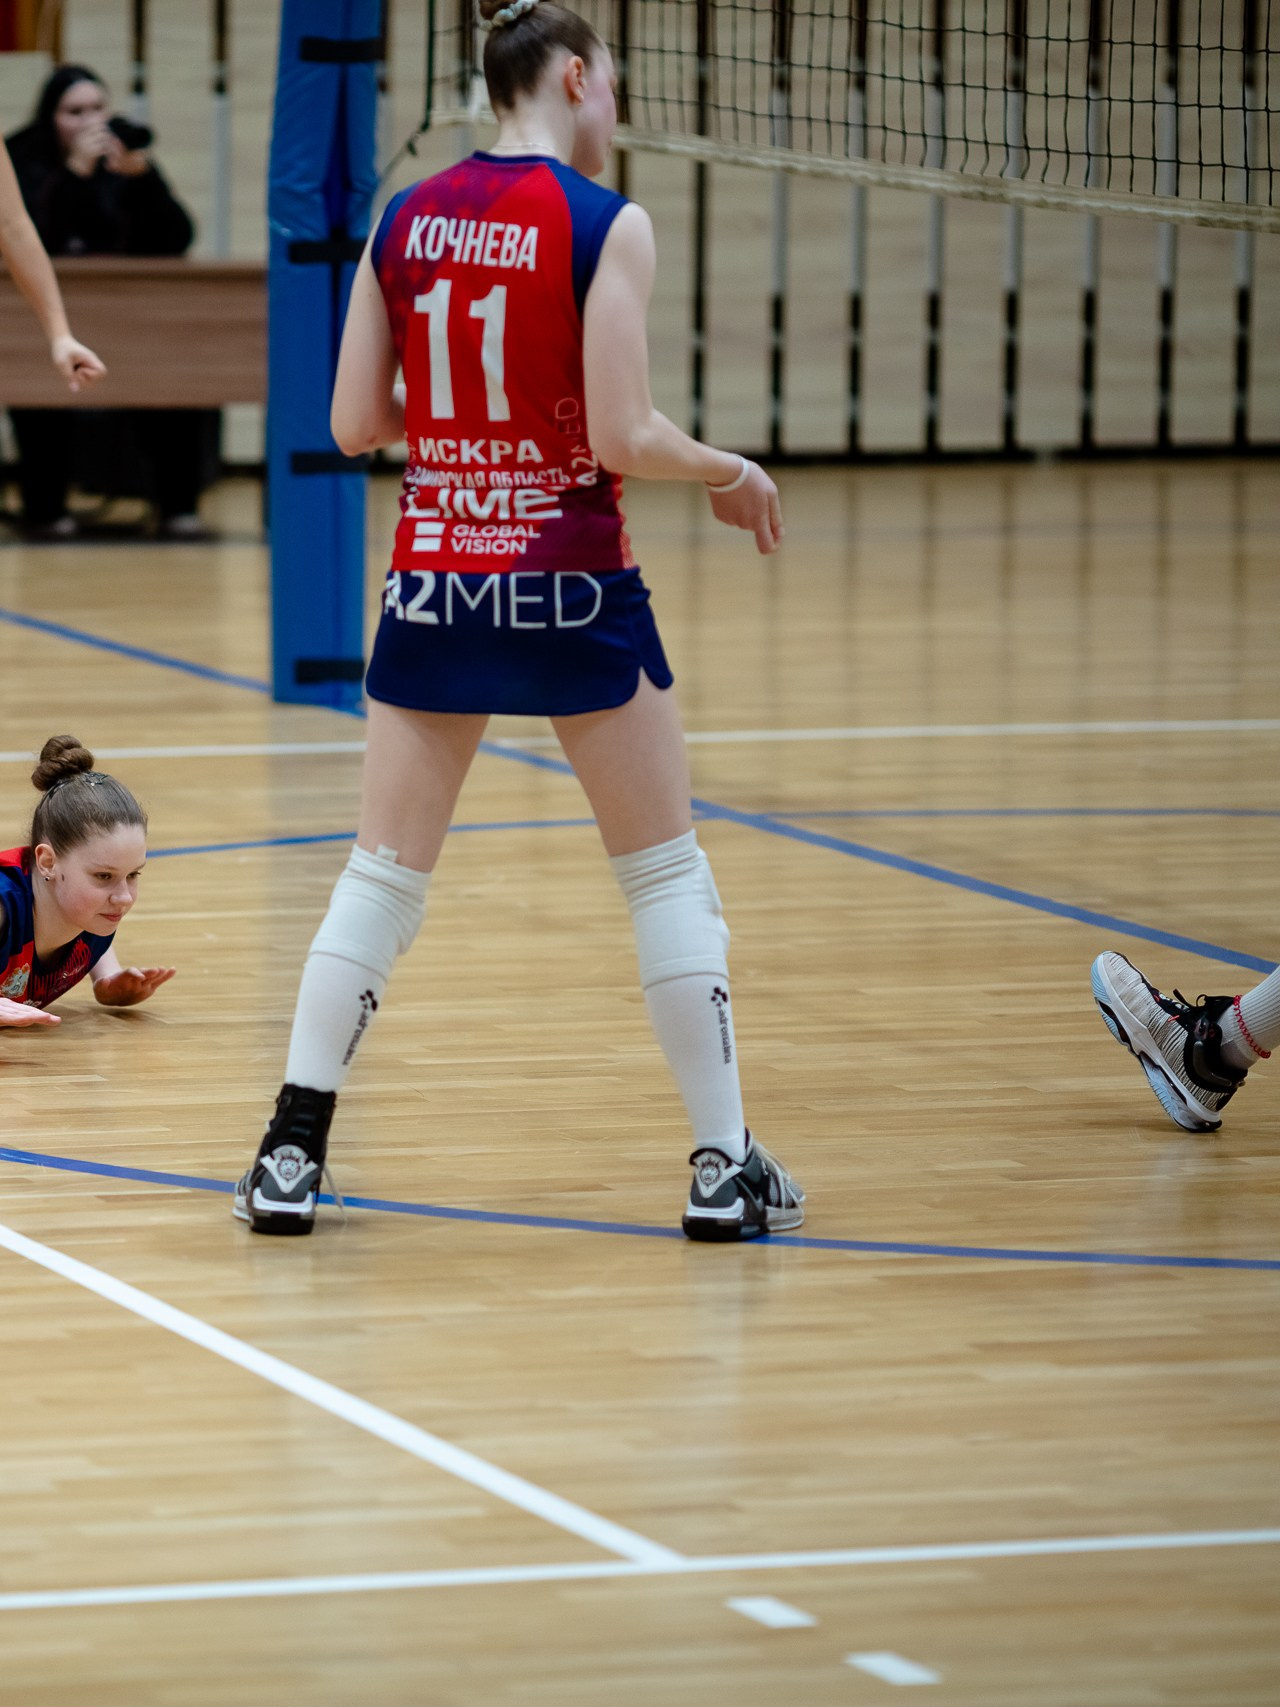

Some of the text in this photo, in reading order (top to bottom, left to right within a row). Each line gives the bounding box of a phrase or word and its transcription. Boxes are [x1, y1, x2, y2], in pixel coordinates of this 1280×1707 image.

[404, 215, 538, 272] КОЧНЕВА
[414, 278, 511, 422] 11
[418, 436, 544, 465] ИСКРА
[488, 467, 571, 489] ОБЛАСТЬ
[404, 487, 563, 520] LIME
[450, 537, 527, 554] VISION
[452, 524, 541, 538] GLOBAL
[385, 570, 603, 629] A2MED
